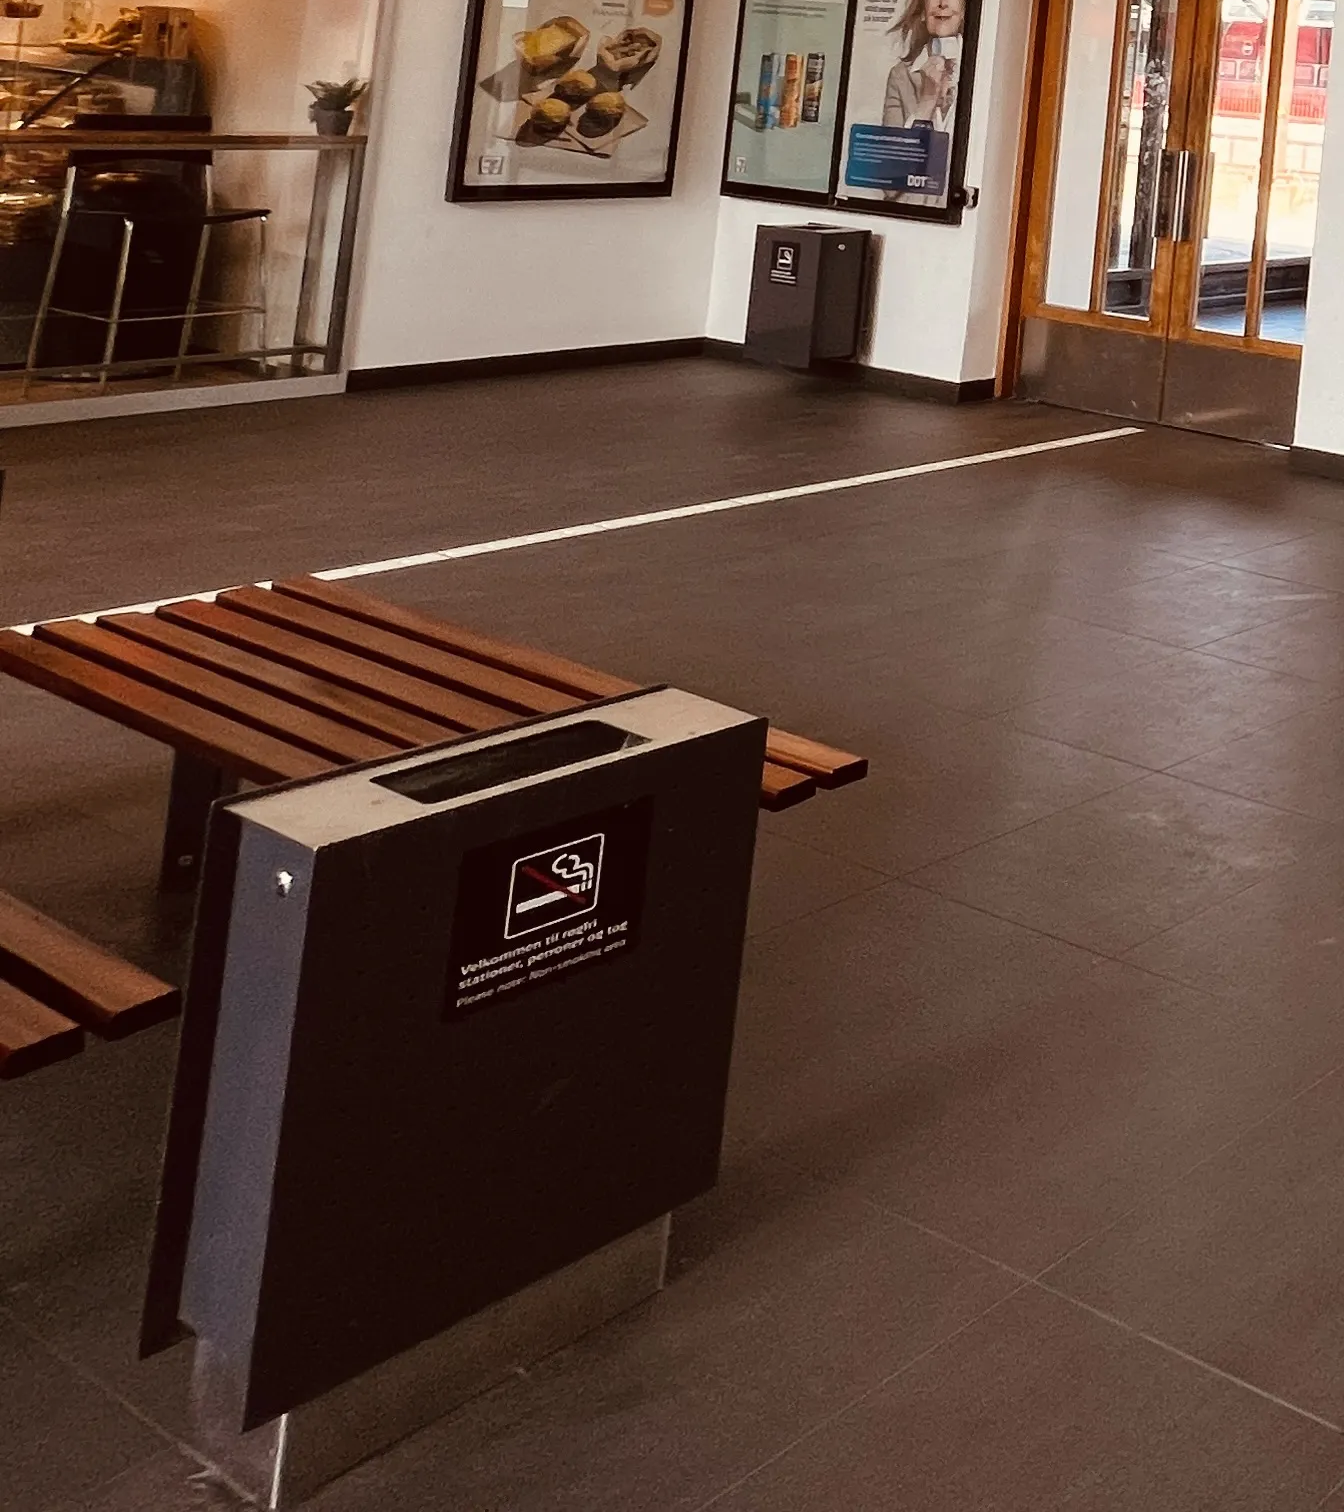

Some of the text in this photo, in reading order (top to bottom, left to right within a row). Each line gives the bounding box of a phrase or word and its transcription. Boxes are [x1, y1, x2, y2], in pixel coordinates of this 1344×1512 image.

[907, 175, 928, 187] DOT
[456, 988, 495, 1008] Please
[529, 948, 602, 980] Non-smoking
[603, 939, 626, 952] area
[458, 921, 628, 990] stationer, perroner og tog
[461, 918, 598, 975] Velkommen til røgfri
